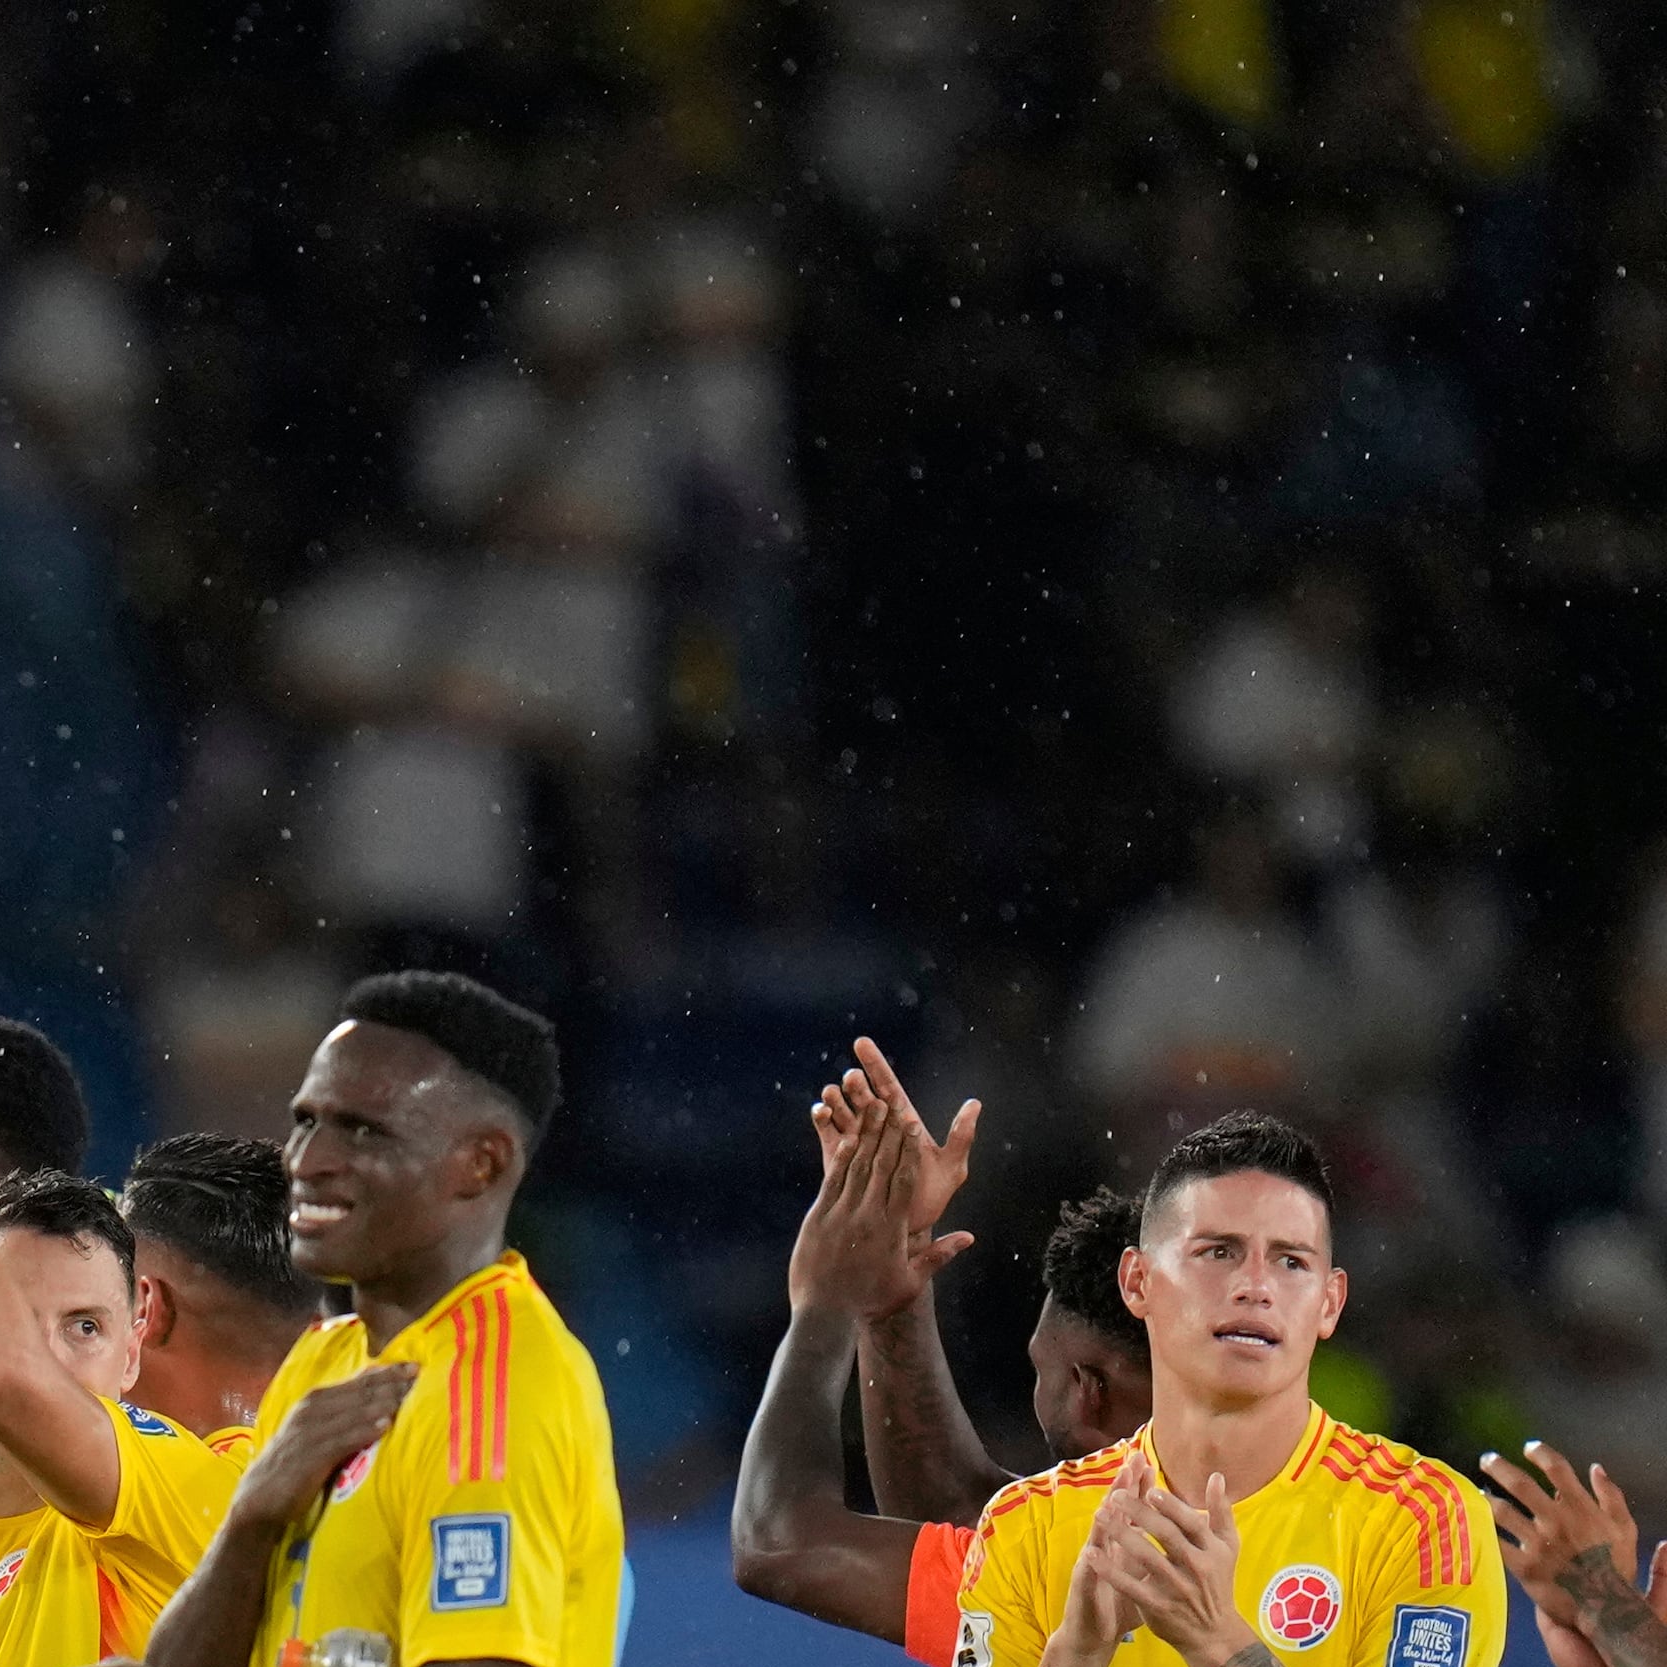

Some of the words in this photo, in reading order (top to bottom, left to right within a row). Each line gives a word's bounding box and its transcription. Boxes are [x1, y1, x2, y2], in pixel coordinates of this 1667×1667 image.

[1412, 1618, 1453, 1636] FOOTBALL
[1409, 1629, 1452, 1652] UNITES
[1403, 1644, 1421, 1658] the
[1421, 1648, 1454, 1666] World
